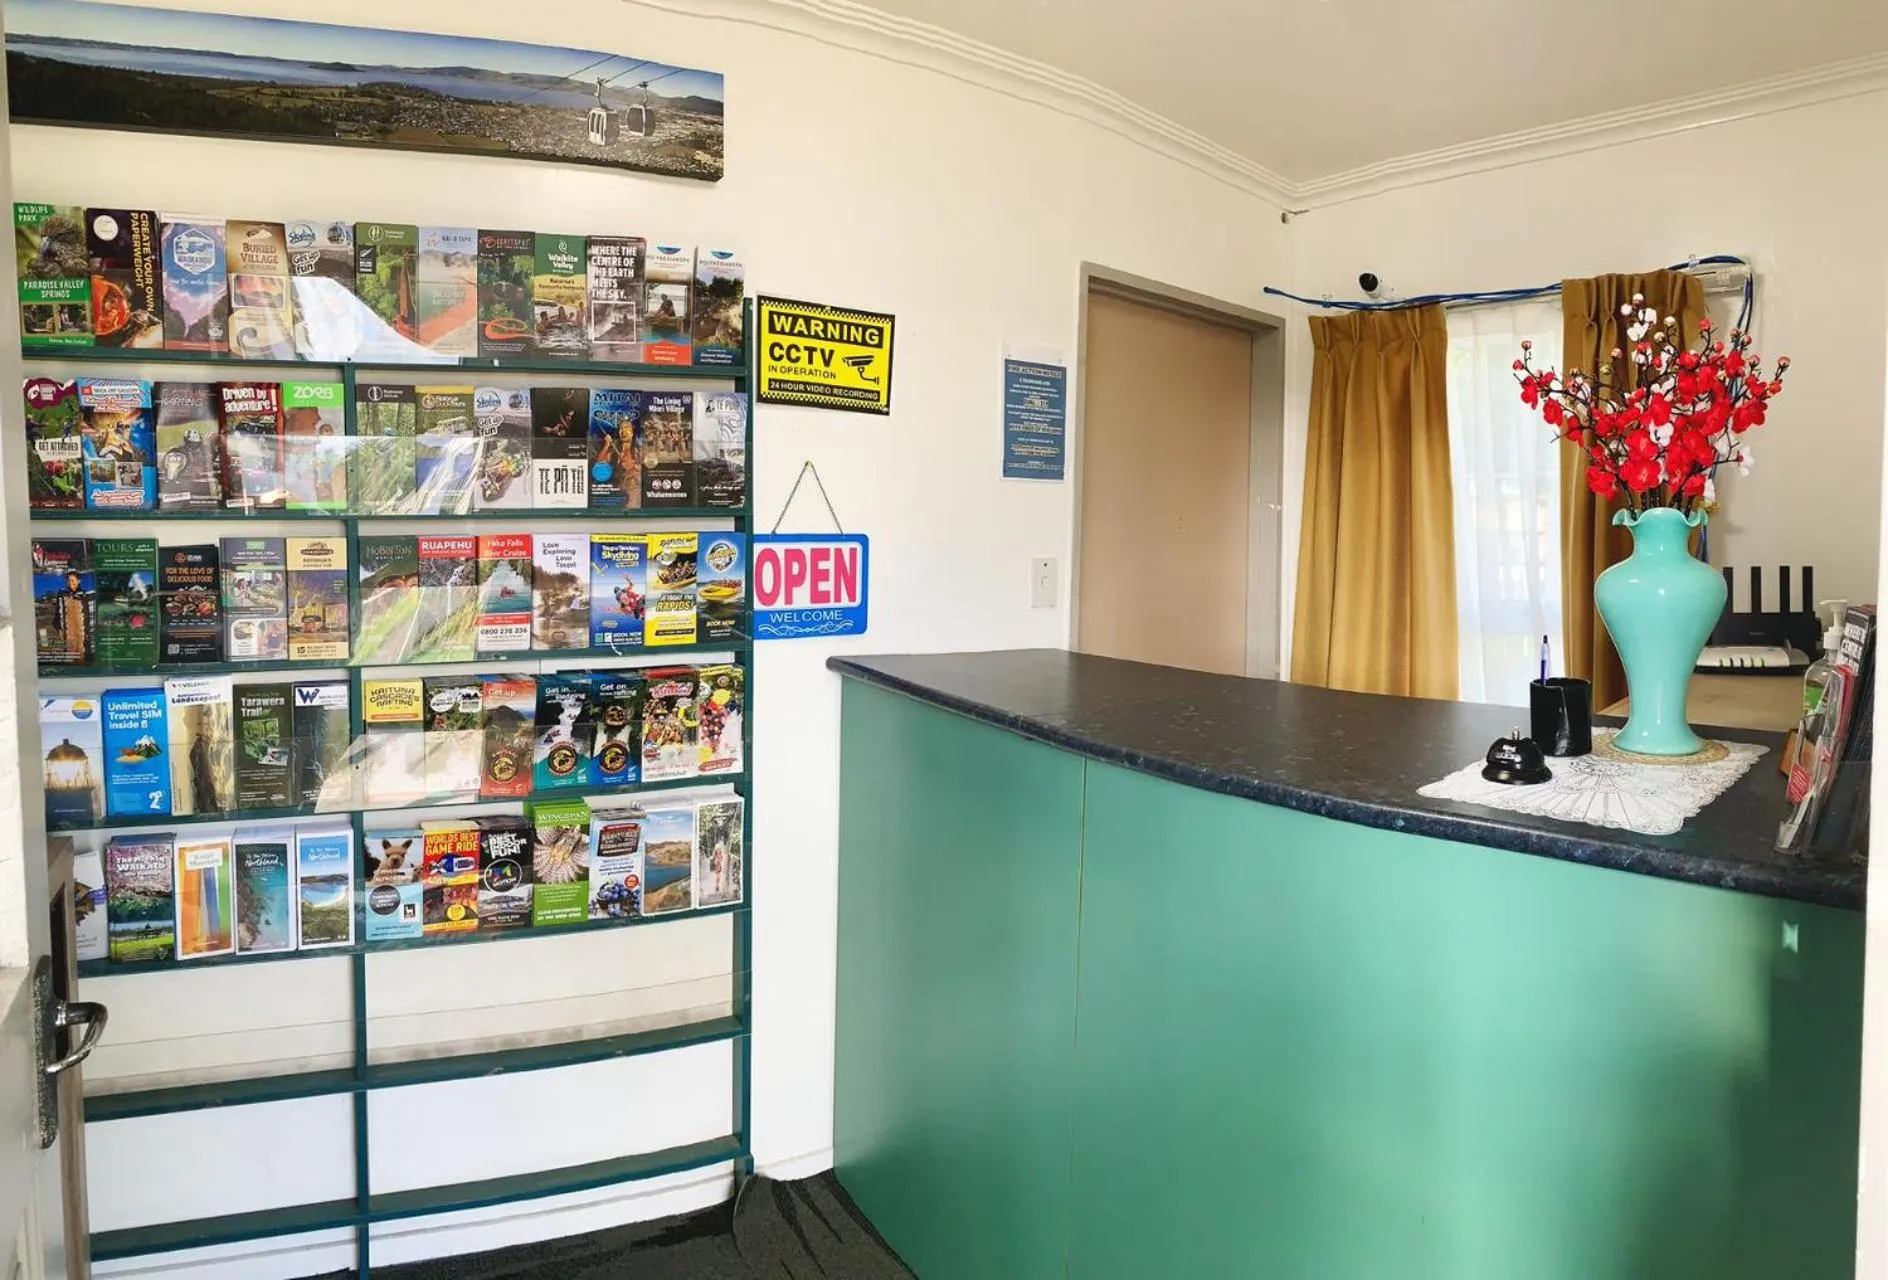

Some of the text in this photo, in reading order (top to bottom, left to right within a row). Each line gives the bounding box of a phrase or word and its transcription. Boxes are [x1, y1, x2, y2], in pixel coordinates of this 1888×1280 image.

[18, 205, 48, 214] WILDLIFE
[130, 212, 144, 289] PAPERWEIGHT
[242, 243, 277, 253] BURIED
[591, 245, 637, 256] WHERE THE
[139, 212, 154, 313] CREATE YOUR OWN
[240, 253, 279, 264] VILLAGE
[591, 257, 635, 268] CENTRE OF
[295, 261, 313, 274] fun
[592, 267, 634, 278] THE EARTH
[23, 280, 84, 290] PARADISE VALLEY
[592, 277, 618, 289] MEETS
[41, 290, 70, 298] SPRINGS
[591, 289, 607, 299] THE
[773, 314, 880, 345] WARNING
[769, 342, 835, 368] CCTV
[779, 366, 837, 380] OPERATION
[222, 388, 267, 401] Driven by
[770, 381, 879, 401] 24 HOUR VIDEO RECORDING
[480, 427, 497, 437] fun
[421, 541, 473, 551] RUAPEHU
[506, 540, 524, 549] Falls
[542, 548, 576, 557] Exploring
[601, 550, 639, 561] Skydiving
[755, 547, 857, 607] OPEN
[770, 610, 843, 624] WELCOME
[505, 690, 516, 698] up
[545, 687, 559, 695] Get
[108, 701, 158, 711] Unlimited
[240, 697, 285, 707] Tarawera
[108, 710, 162, 721] Travel SIM
[241, 707, 263, 717] Trail
[109, 720, 140, 730] inside
[461, 833, 479, 843] BEST
[488, 833, 516, 845] BEST
[425, 840, 478, 856] GAME RIDE
[491, 845, 521, 859] FUN!
[308, 851, 341, 861] Northland
[245, 858, 279, 868] Northland
